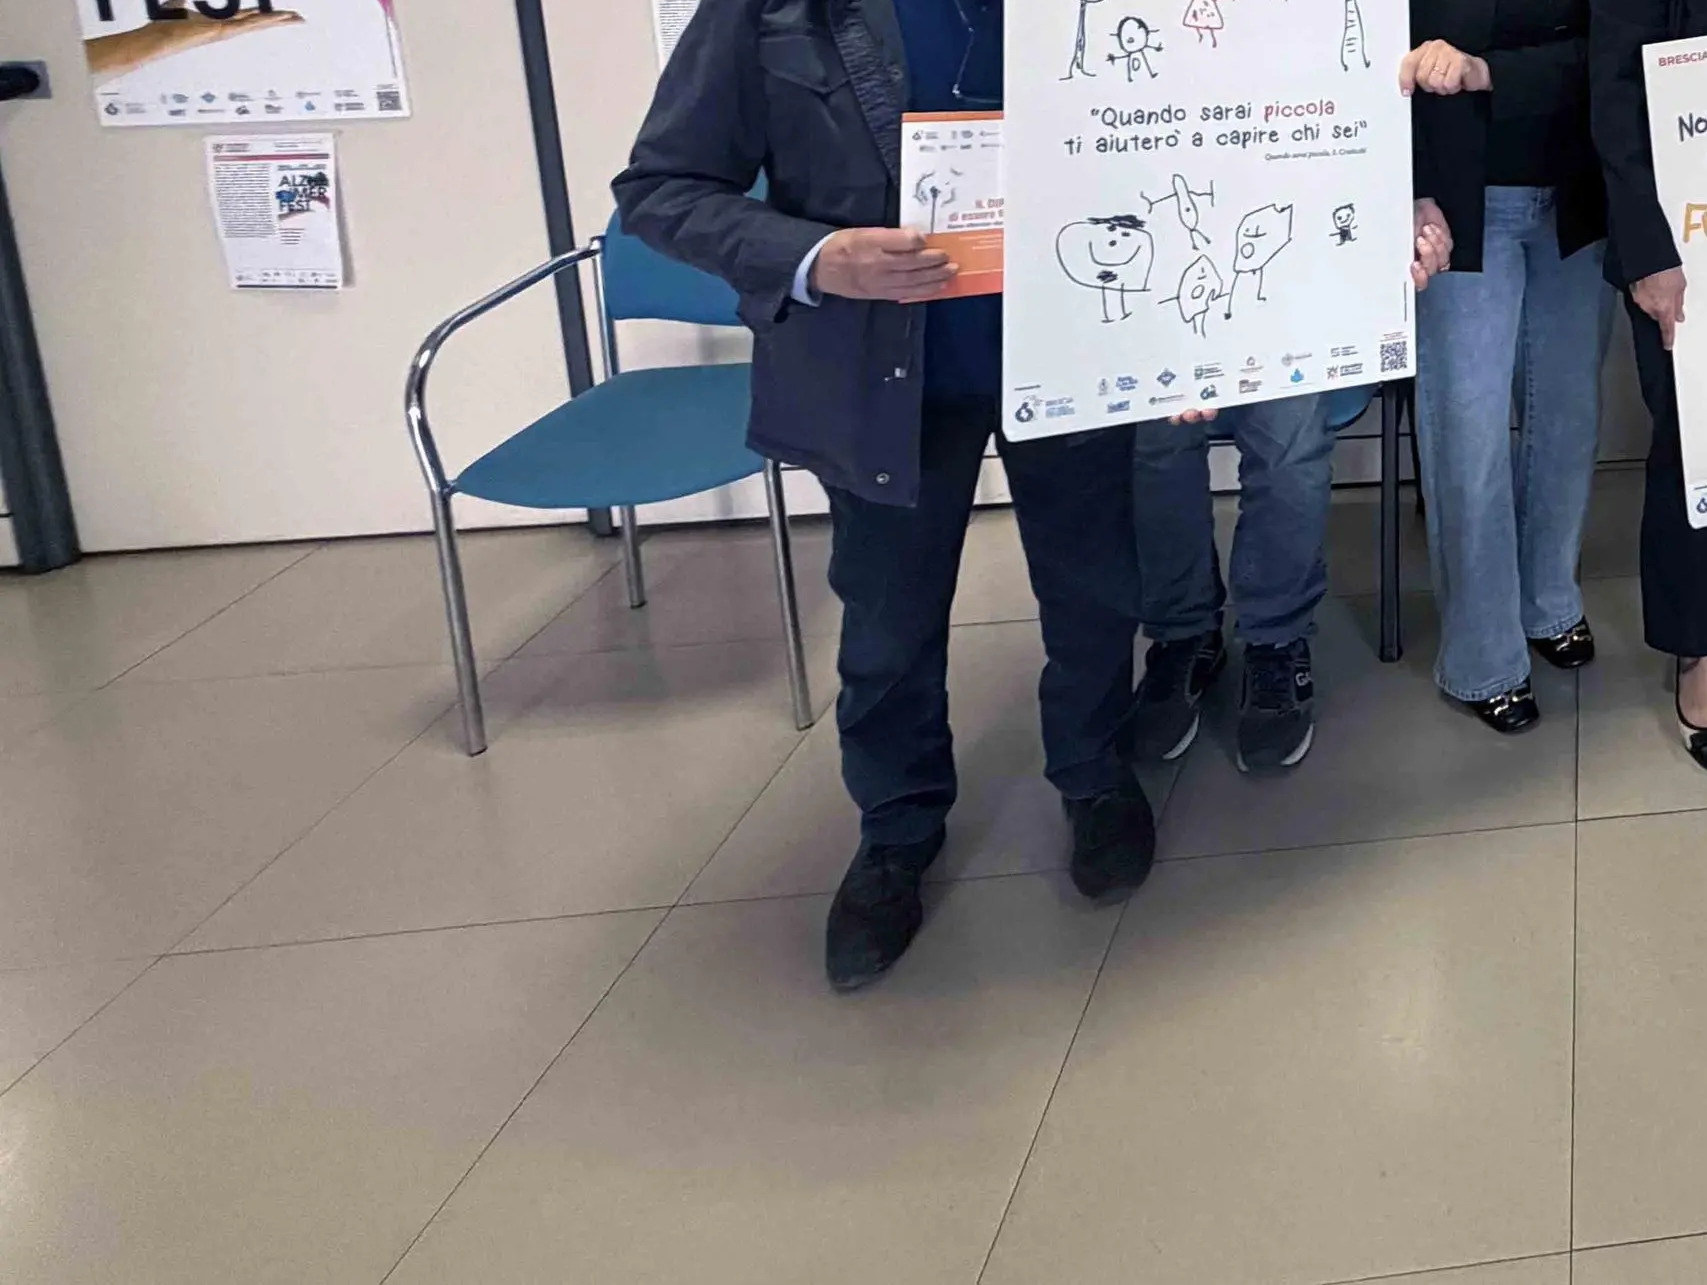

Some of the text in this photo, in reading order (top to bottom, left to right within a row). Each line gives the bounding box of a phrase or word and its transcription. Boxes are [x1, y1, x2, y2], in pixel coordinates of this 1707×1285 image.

[1200, 101, 1252, 120] sarai
[1264, 99, 1336, 123] piccola
[1064, 136, 1082, 155] ti
[1095, 129, 1182, 153] aiuterò
[1191, 135, 1204, 148] a
[1216, 127, 1280, 149] capire
[1291, 123, 1321, 143] chi
